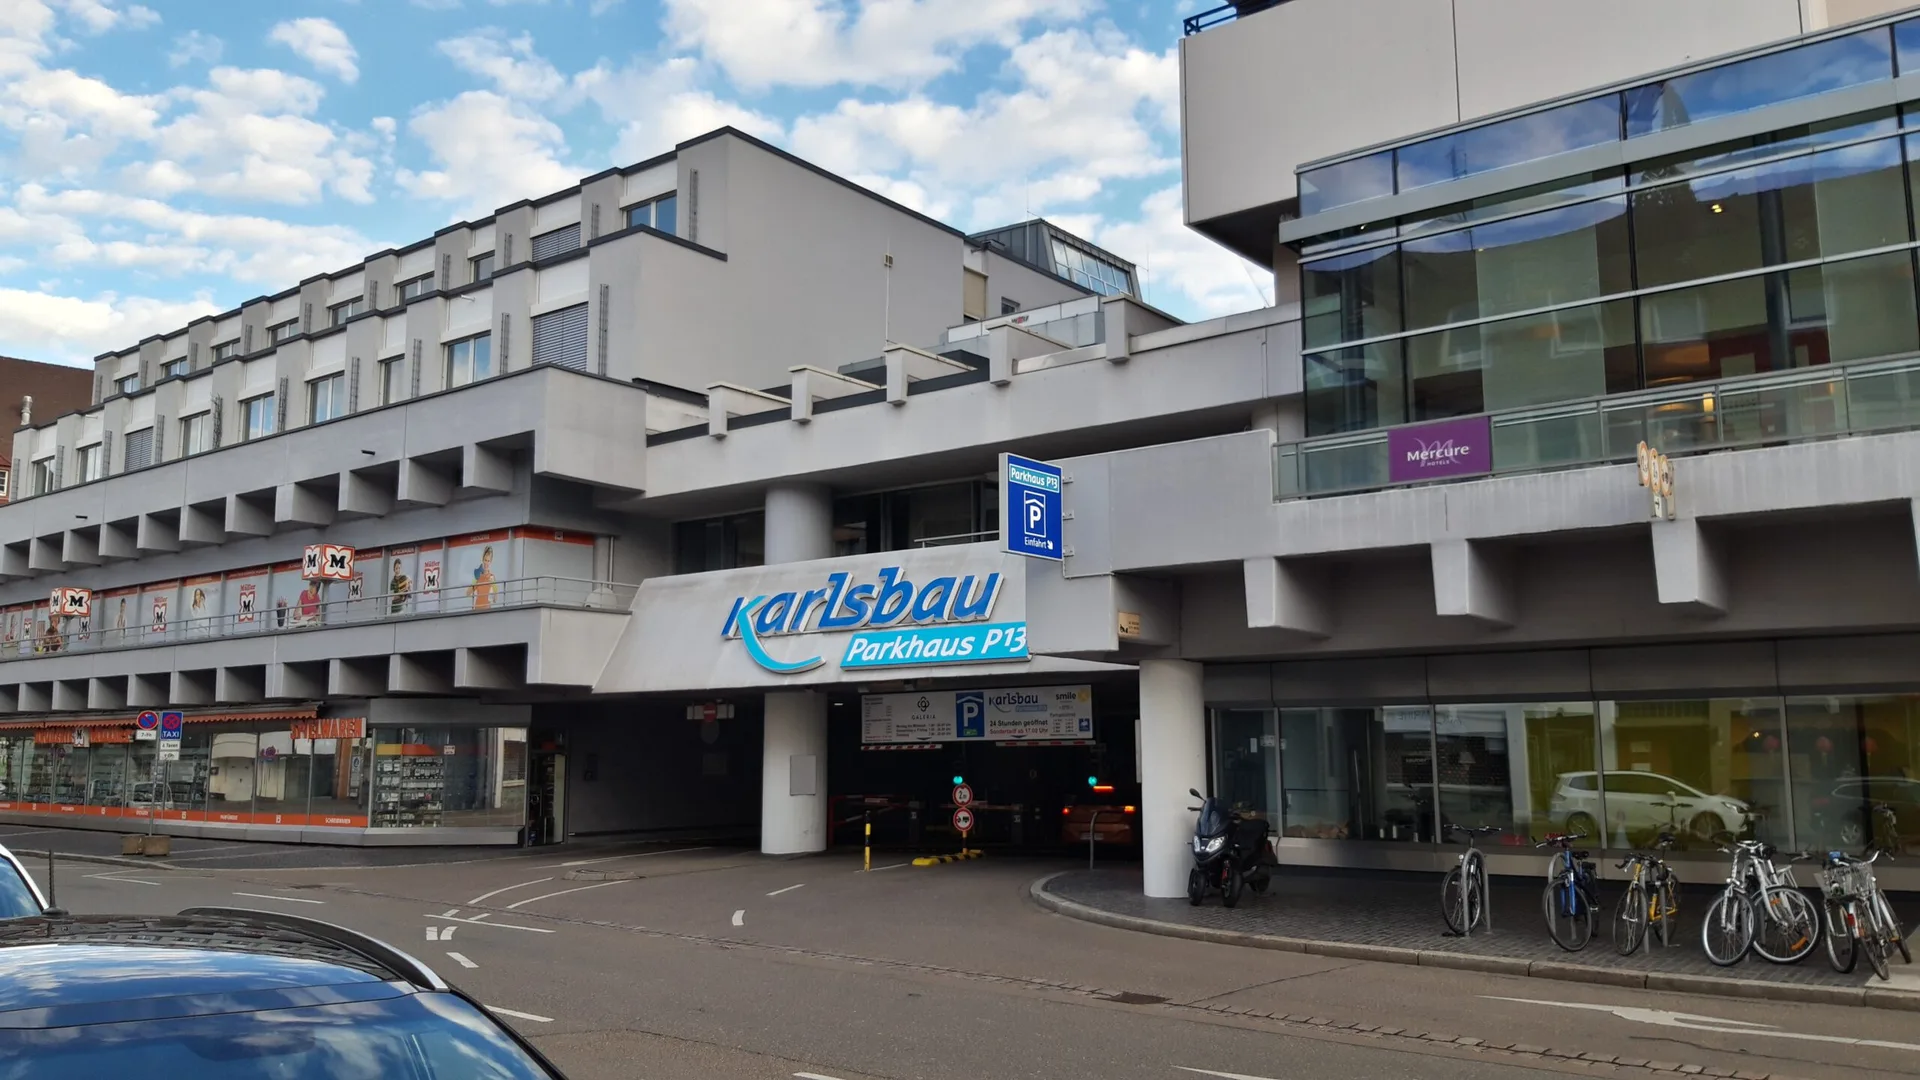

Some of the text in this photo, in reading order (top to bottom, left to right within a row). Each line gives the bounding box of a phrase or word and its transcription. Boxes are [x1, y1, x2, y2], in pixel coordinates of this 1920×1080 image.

[1407, 445, 1469, 461] Mercure
[1011, 468, 1058, 489] Parkhaus P13
[1029, 505, 1042, 529] P
[1024, 536, 1047, 549] Einfahrt
[307, 553, 317, 568] M
[330, 554, 346, 569] M
[69, 595, 84, 607] M
[721, 565, 1004, 673] Karlsbau
[846, 627, 1027, 663] Parkhaus P13
[989, 692, 1038, 710] Karlsbau
[1055, 691, 1077, 700] smile
[962, 702, 979, 727] P
[998, 719, 1022, 727] Stunden
[1023, 719, 1048, 727] geöffnet
[162, 730, 180, 738] TAXI
